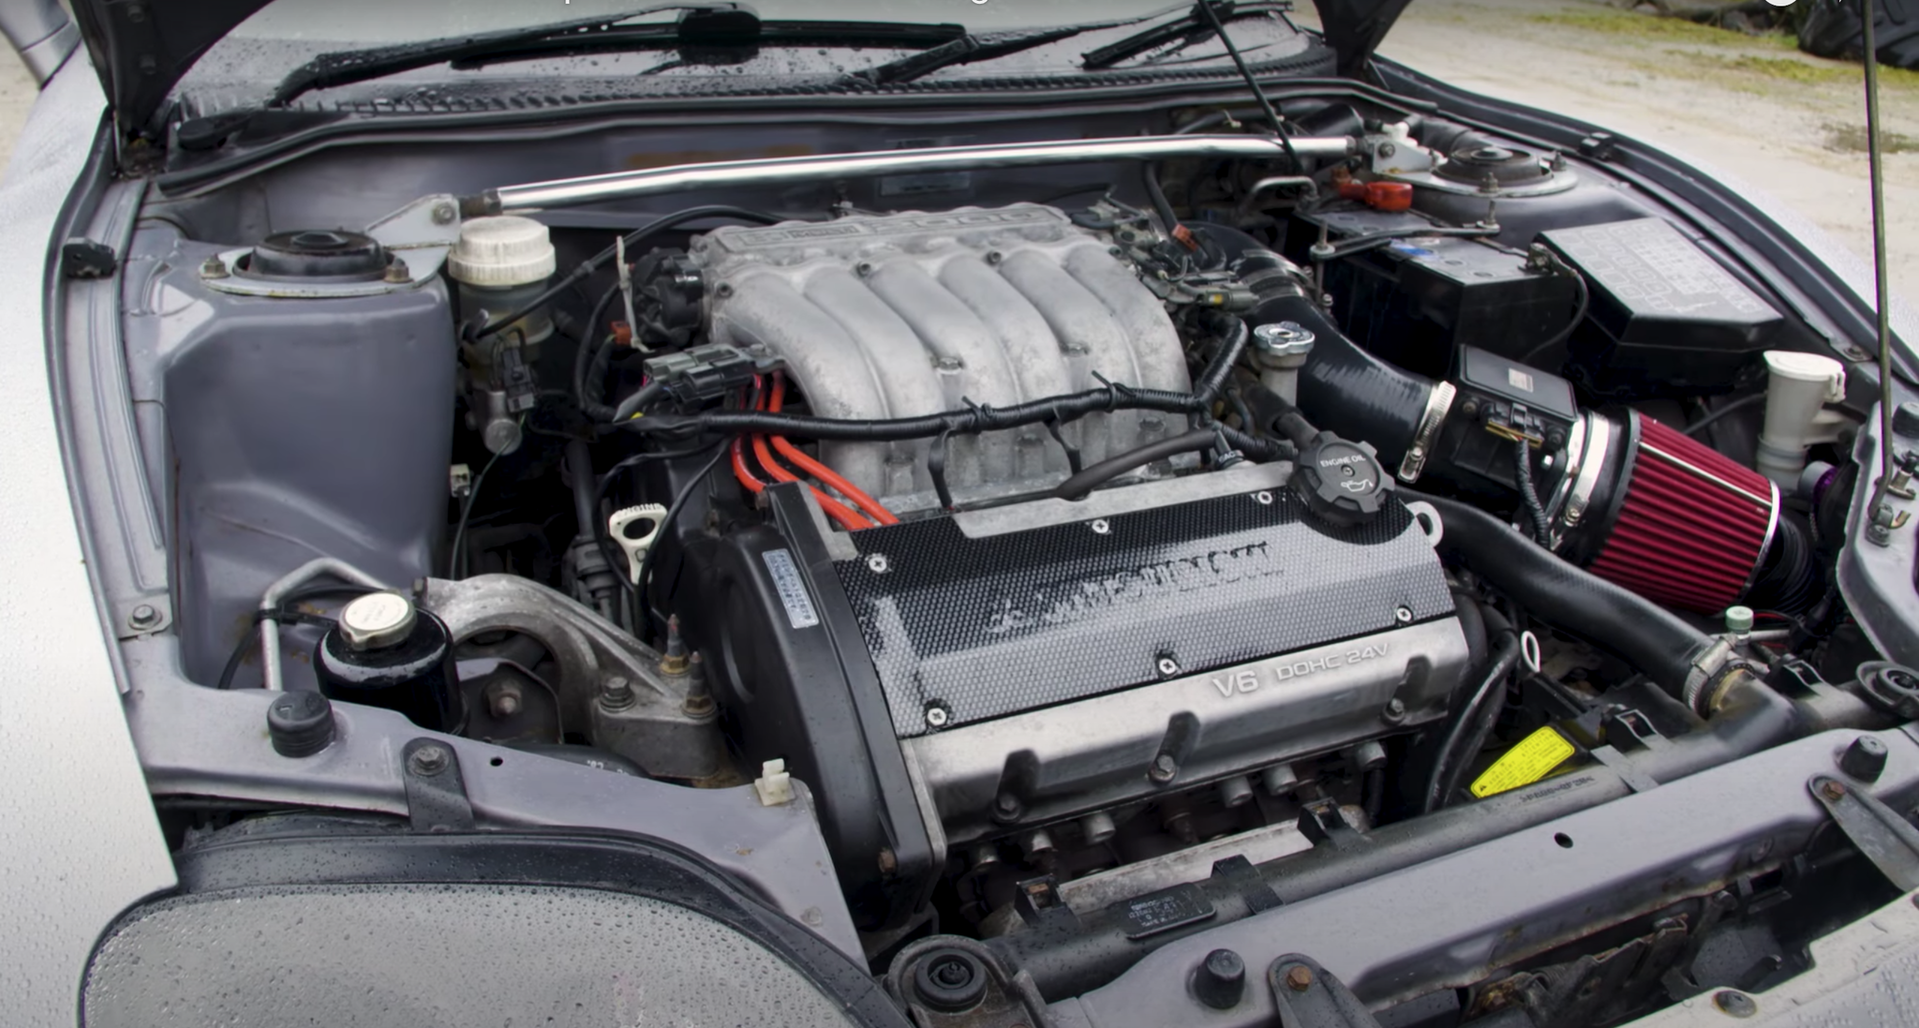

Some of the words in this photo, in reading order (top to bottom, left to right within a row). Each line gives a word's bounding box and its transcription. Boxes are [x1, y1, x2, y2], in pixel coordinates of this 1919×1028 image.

[1320, 455, 1352, 468] ENGINE
[1351, 454, 1367, 463] OIL
[1212, 670, 1259, 698] V6
[1275, 654, 1342, 681] DOHC
[1346, 643, 1388, 665] 24V
